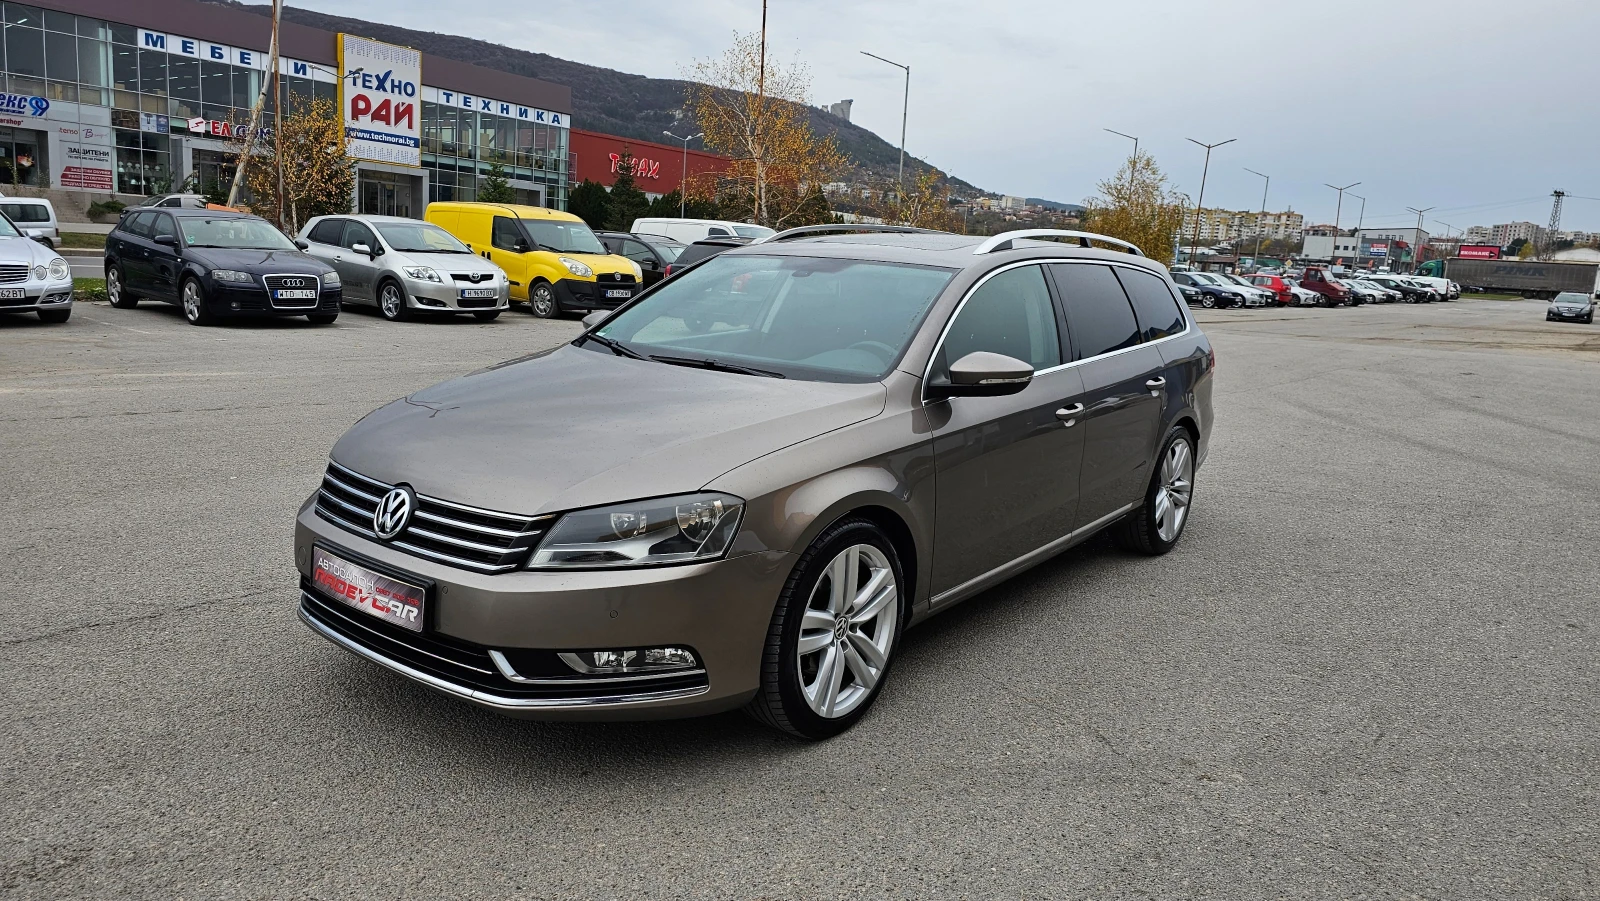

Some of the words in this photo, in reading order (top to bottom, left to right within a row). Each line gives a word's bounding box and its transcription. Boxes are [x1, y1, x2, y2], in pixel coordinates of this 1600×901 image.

[144, 32, 306, 76] МЕБЕИ
[349, 70, 415, 97] ТЕХНО
[351, 94, 413, 130] РАЙ
[443, 92, 560, 124] ТЕХНИКА
[350, 130, 415, 147] www.technorai.bg
[318, 557, 374, 591] АВТОСАЛОН
